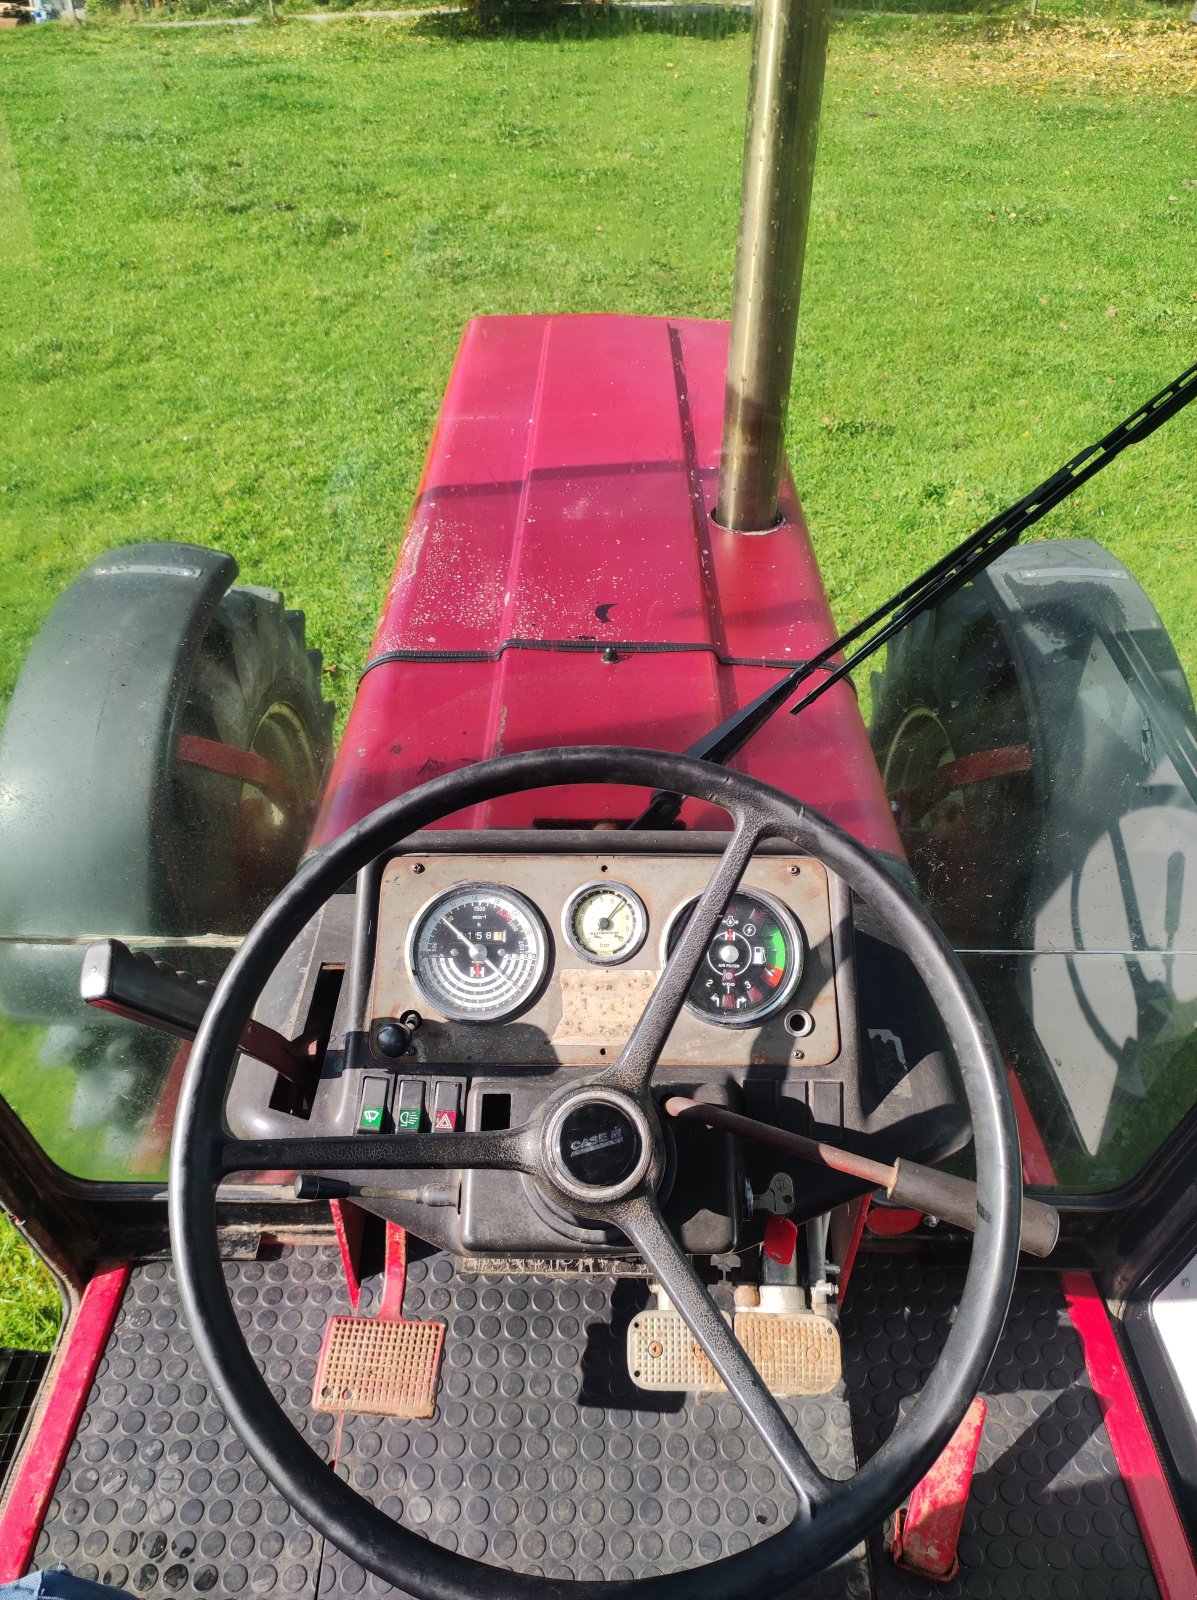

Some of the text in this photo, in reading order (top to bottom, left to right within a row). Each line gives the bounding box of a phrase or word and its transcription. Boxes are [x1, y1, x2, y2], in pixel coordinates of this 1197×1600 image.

[706, 979, 714, 988] 2
[744, 980, 752, 989] 3
[571, 1132, 608, 1150] CASE
